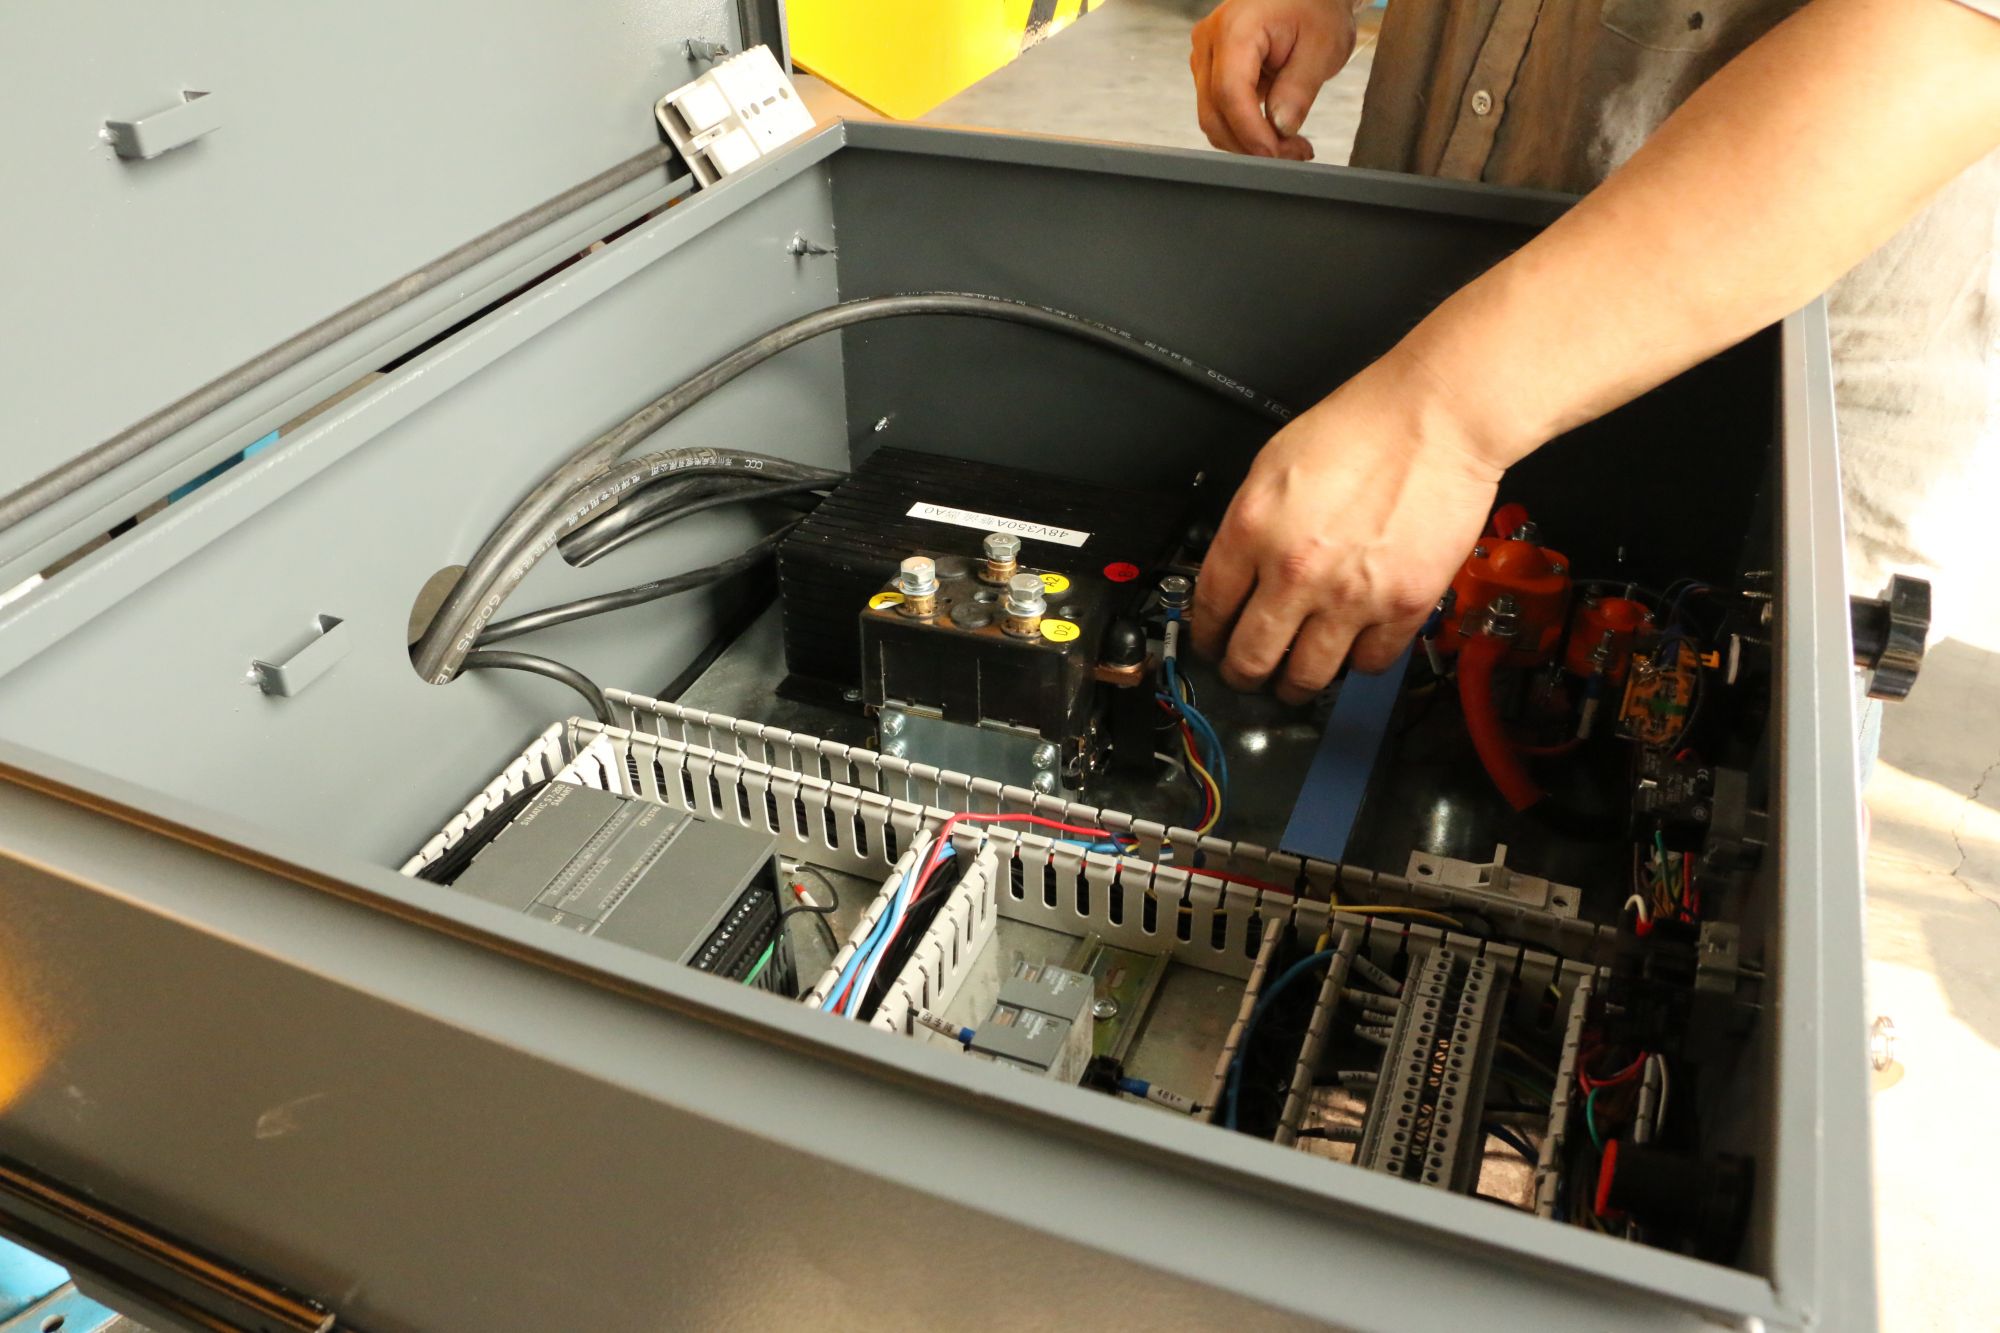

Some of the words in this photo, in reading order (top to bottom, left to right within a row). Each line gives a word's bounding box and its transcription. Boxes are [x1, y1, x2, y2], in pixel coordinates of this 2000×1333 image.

[1206, 368, 1255, 399] 60245
[743, 459, 764, 471] CCC
[456, 593, 502, 652] 60245
[551, 787, 574, 807] SMART
[520, 802, 548, 826] SIMATIC
